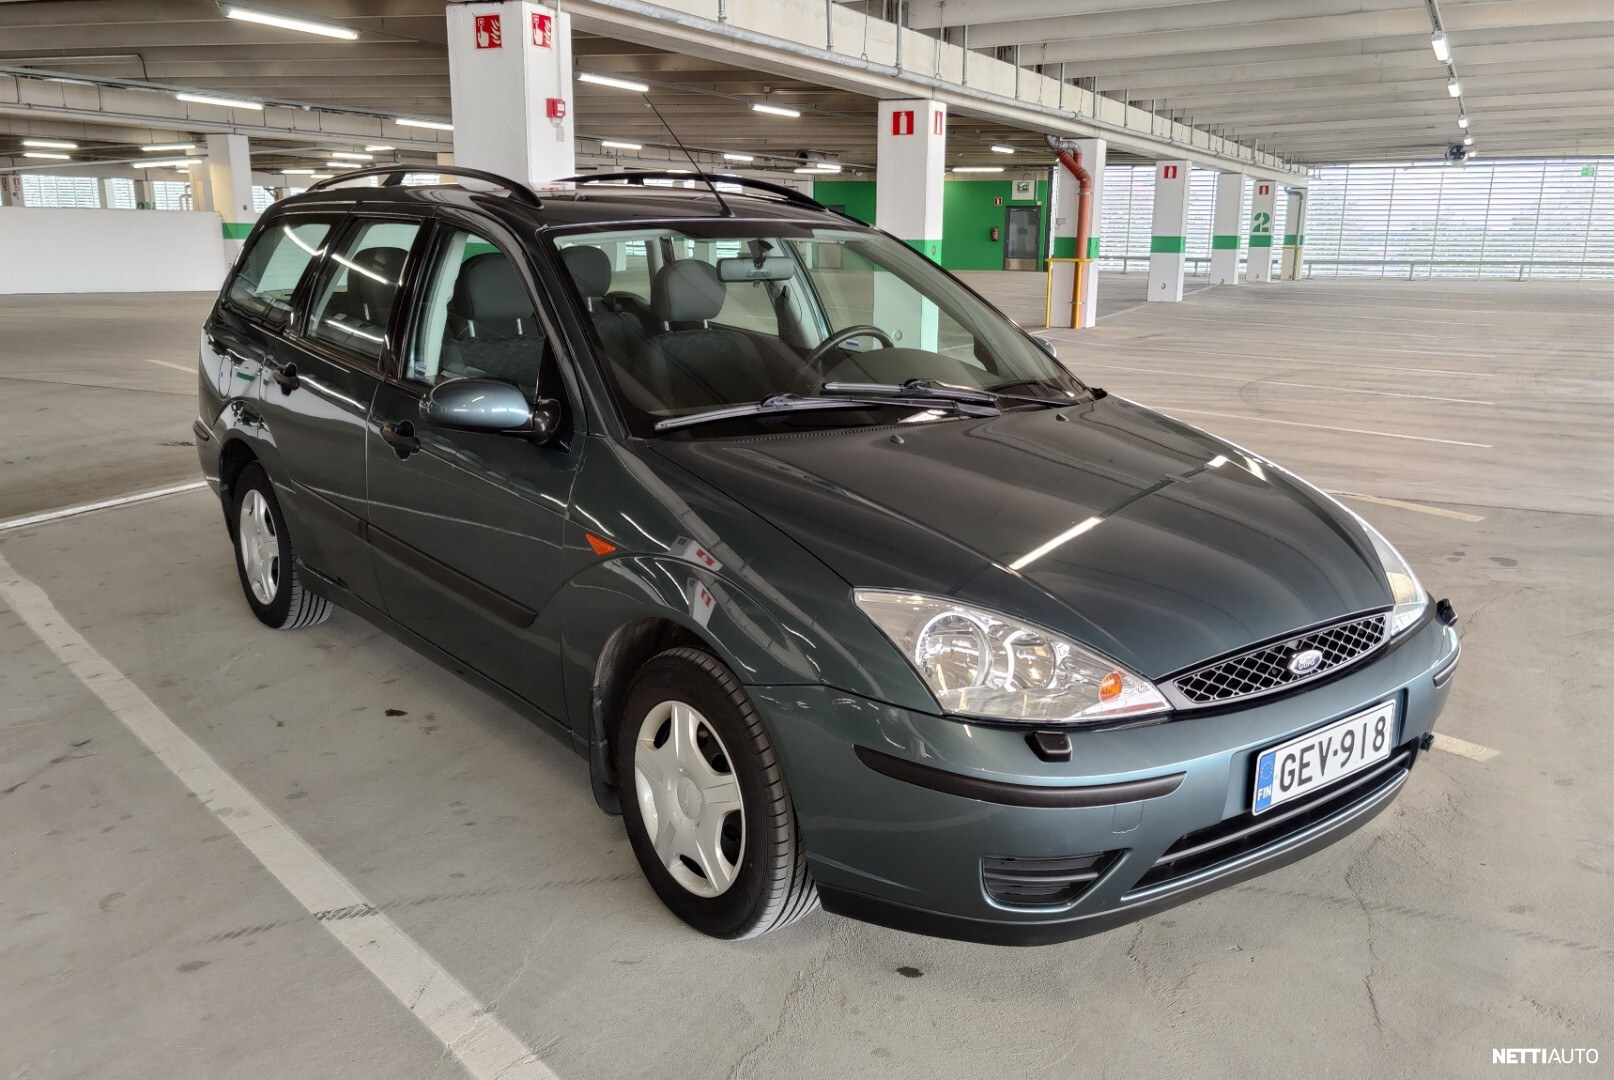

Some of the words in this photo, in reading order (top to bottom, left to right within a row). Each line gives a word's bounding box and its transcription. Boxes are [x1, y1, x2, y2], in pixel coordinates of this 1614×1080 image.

[1252, 212, 1270, 233] 2
[1279, 715, 1386, 793] GEV-918
[1257, 784, 1273, 799] FIN
